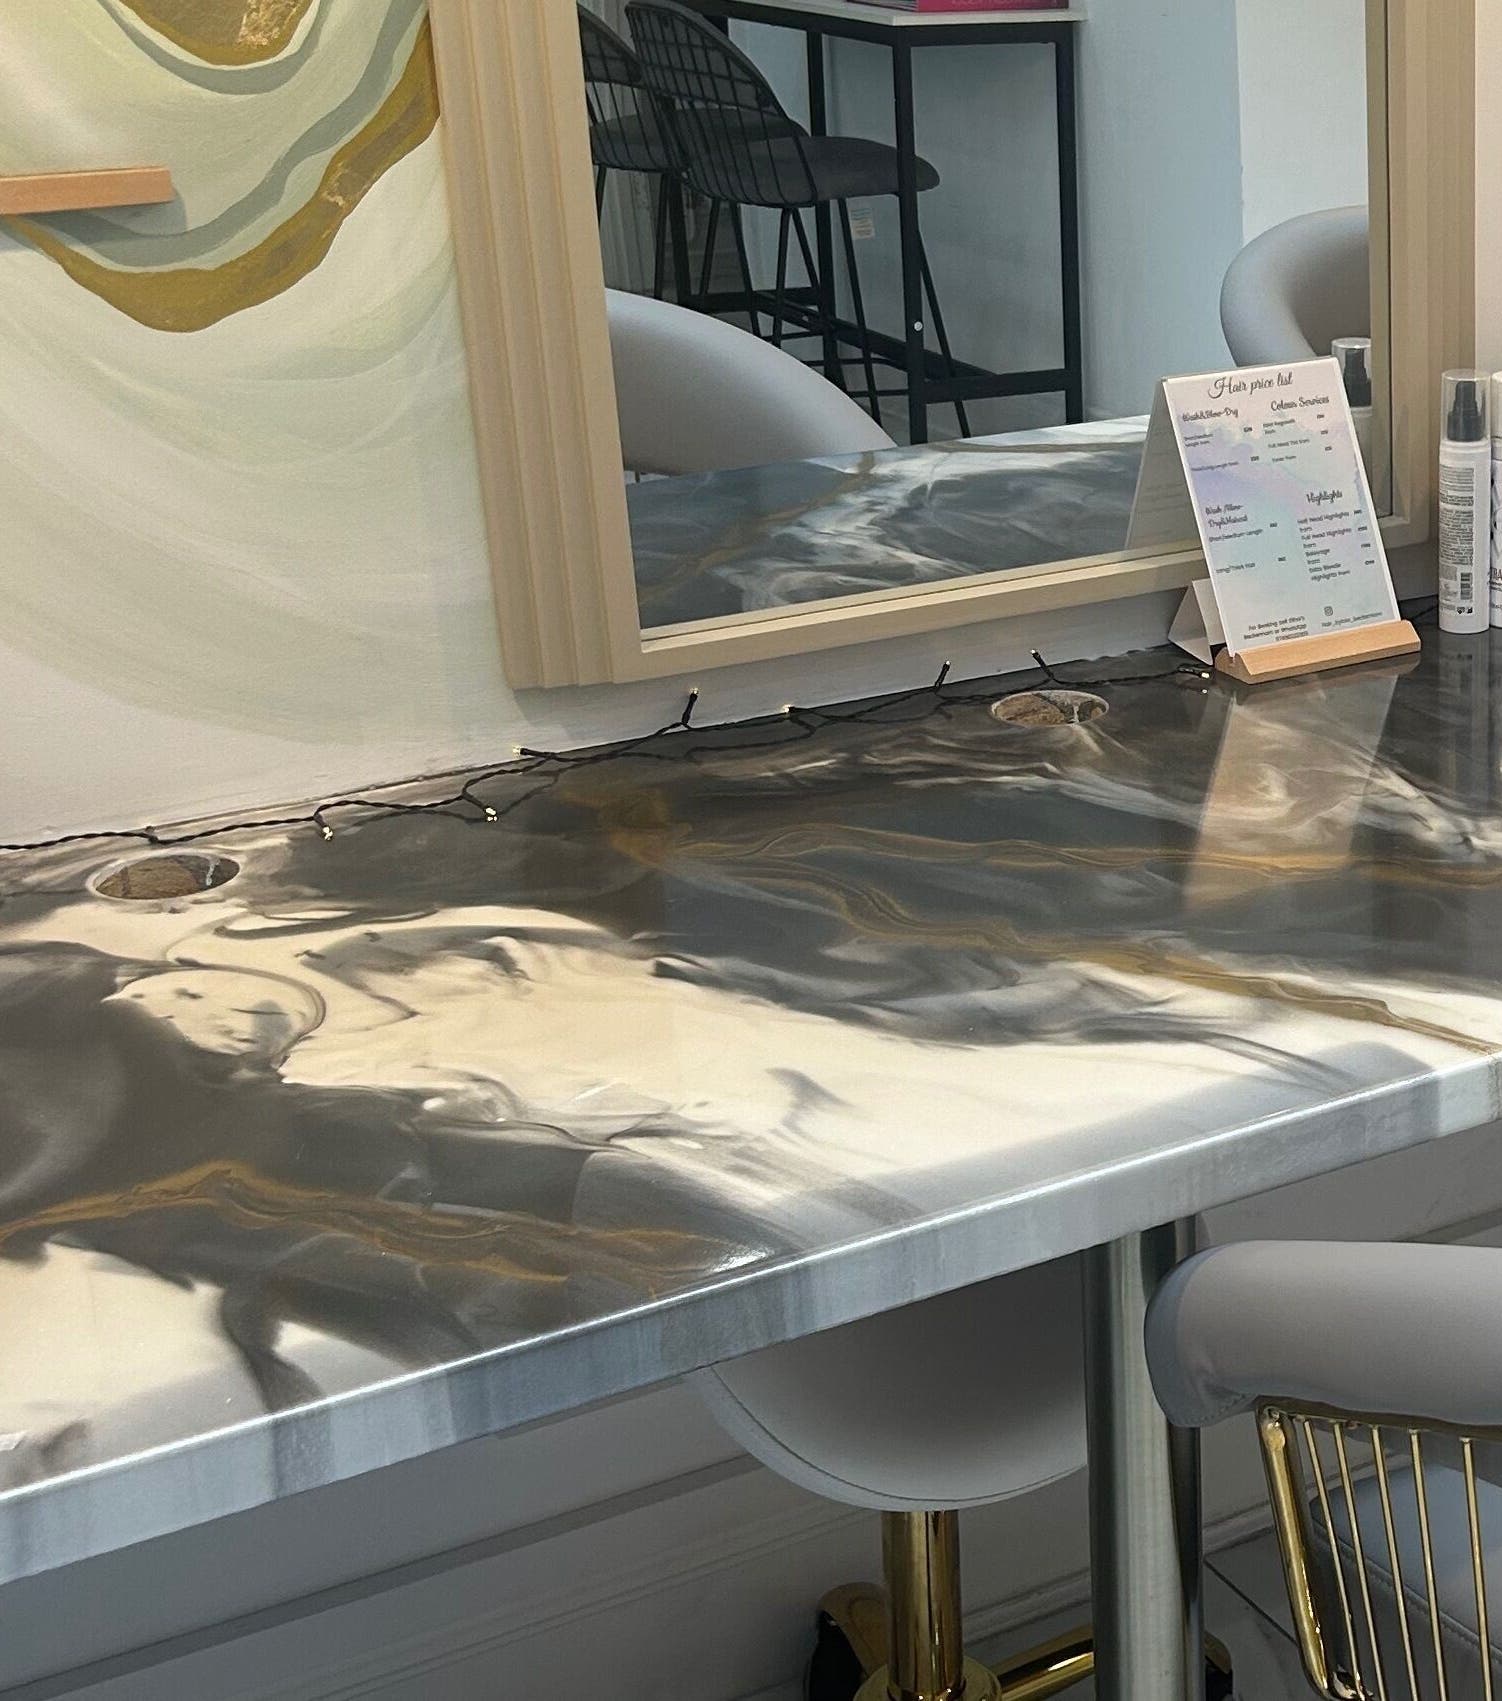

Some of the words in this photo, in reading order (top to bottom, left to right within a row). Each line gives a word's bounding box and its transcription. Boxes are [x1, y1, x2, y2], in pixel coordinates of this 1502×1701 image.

[1208, 376, 1248, 399] Hair
[1250, 377, 1275, 395] price
[1277, 371, 1293, 387] list
